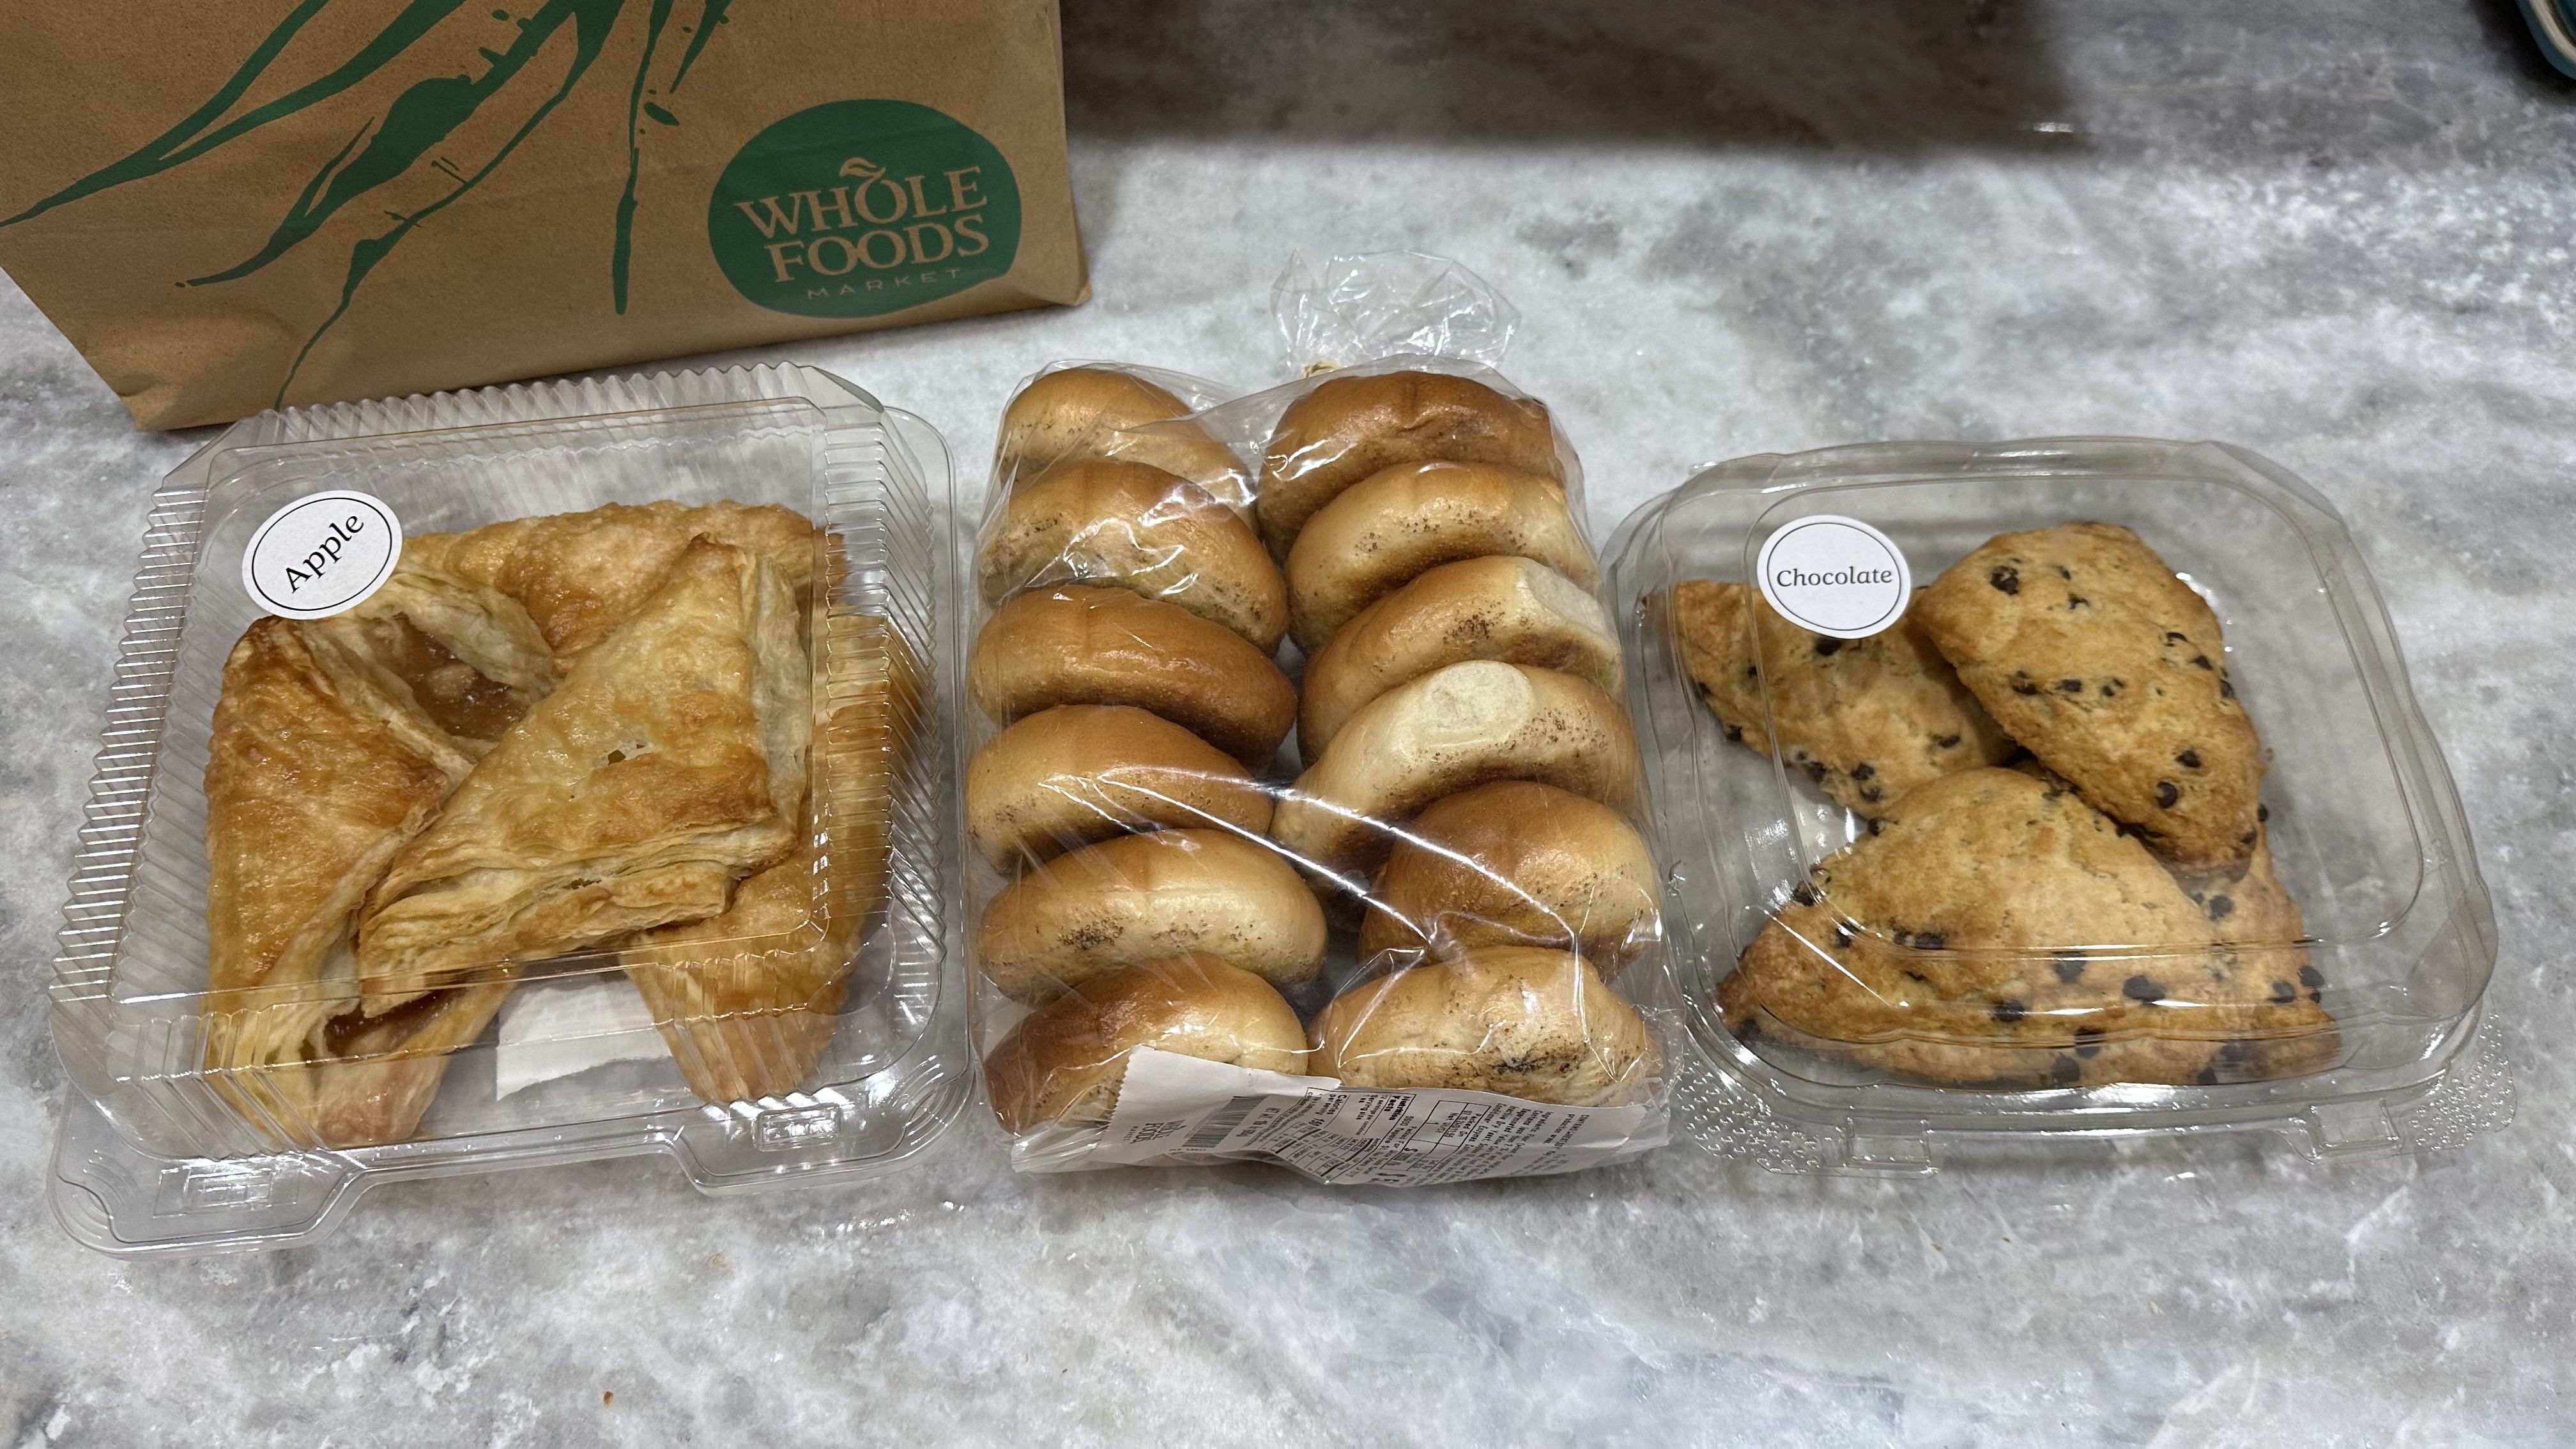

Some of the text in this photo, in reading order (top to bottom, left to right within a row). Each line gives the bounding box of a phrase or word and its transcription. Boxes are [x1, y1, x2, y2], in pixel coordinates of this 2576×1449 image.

[733, 158, 987, 239] WHOLE
[764, 215, 989, 282] FOODS
[807, 268, 961, 300] MARKET
[286, 516, 364, 594] Apple
[1777, 566, 1892, 586] Chocolate
[1326, 1094, 1347, 1115] Calories
[1384, 1096, 1400, 1111] Facts
[1389, 1096, 1411, 1120] Nutrition
[1130, 1123, 1165, 1144] FOODS
